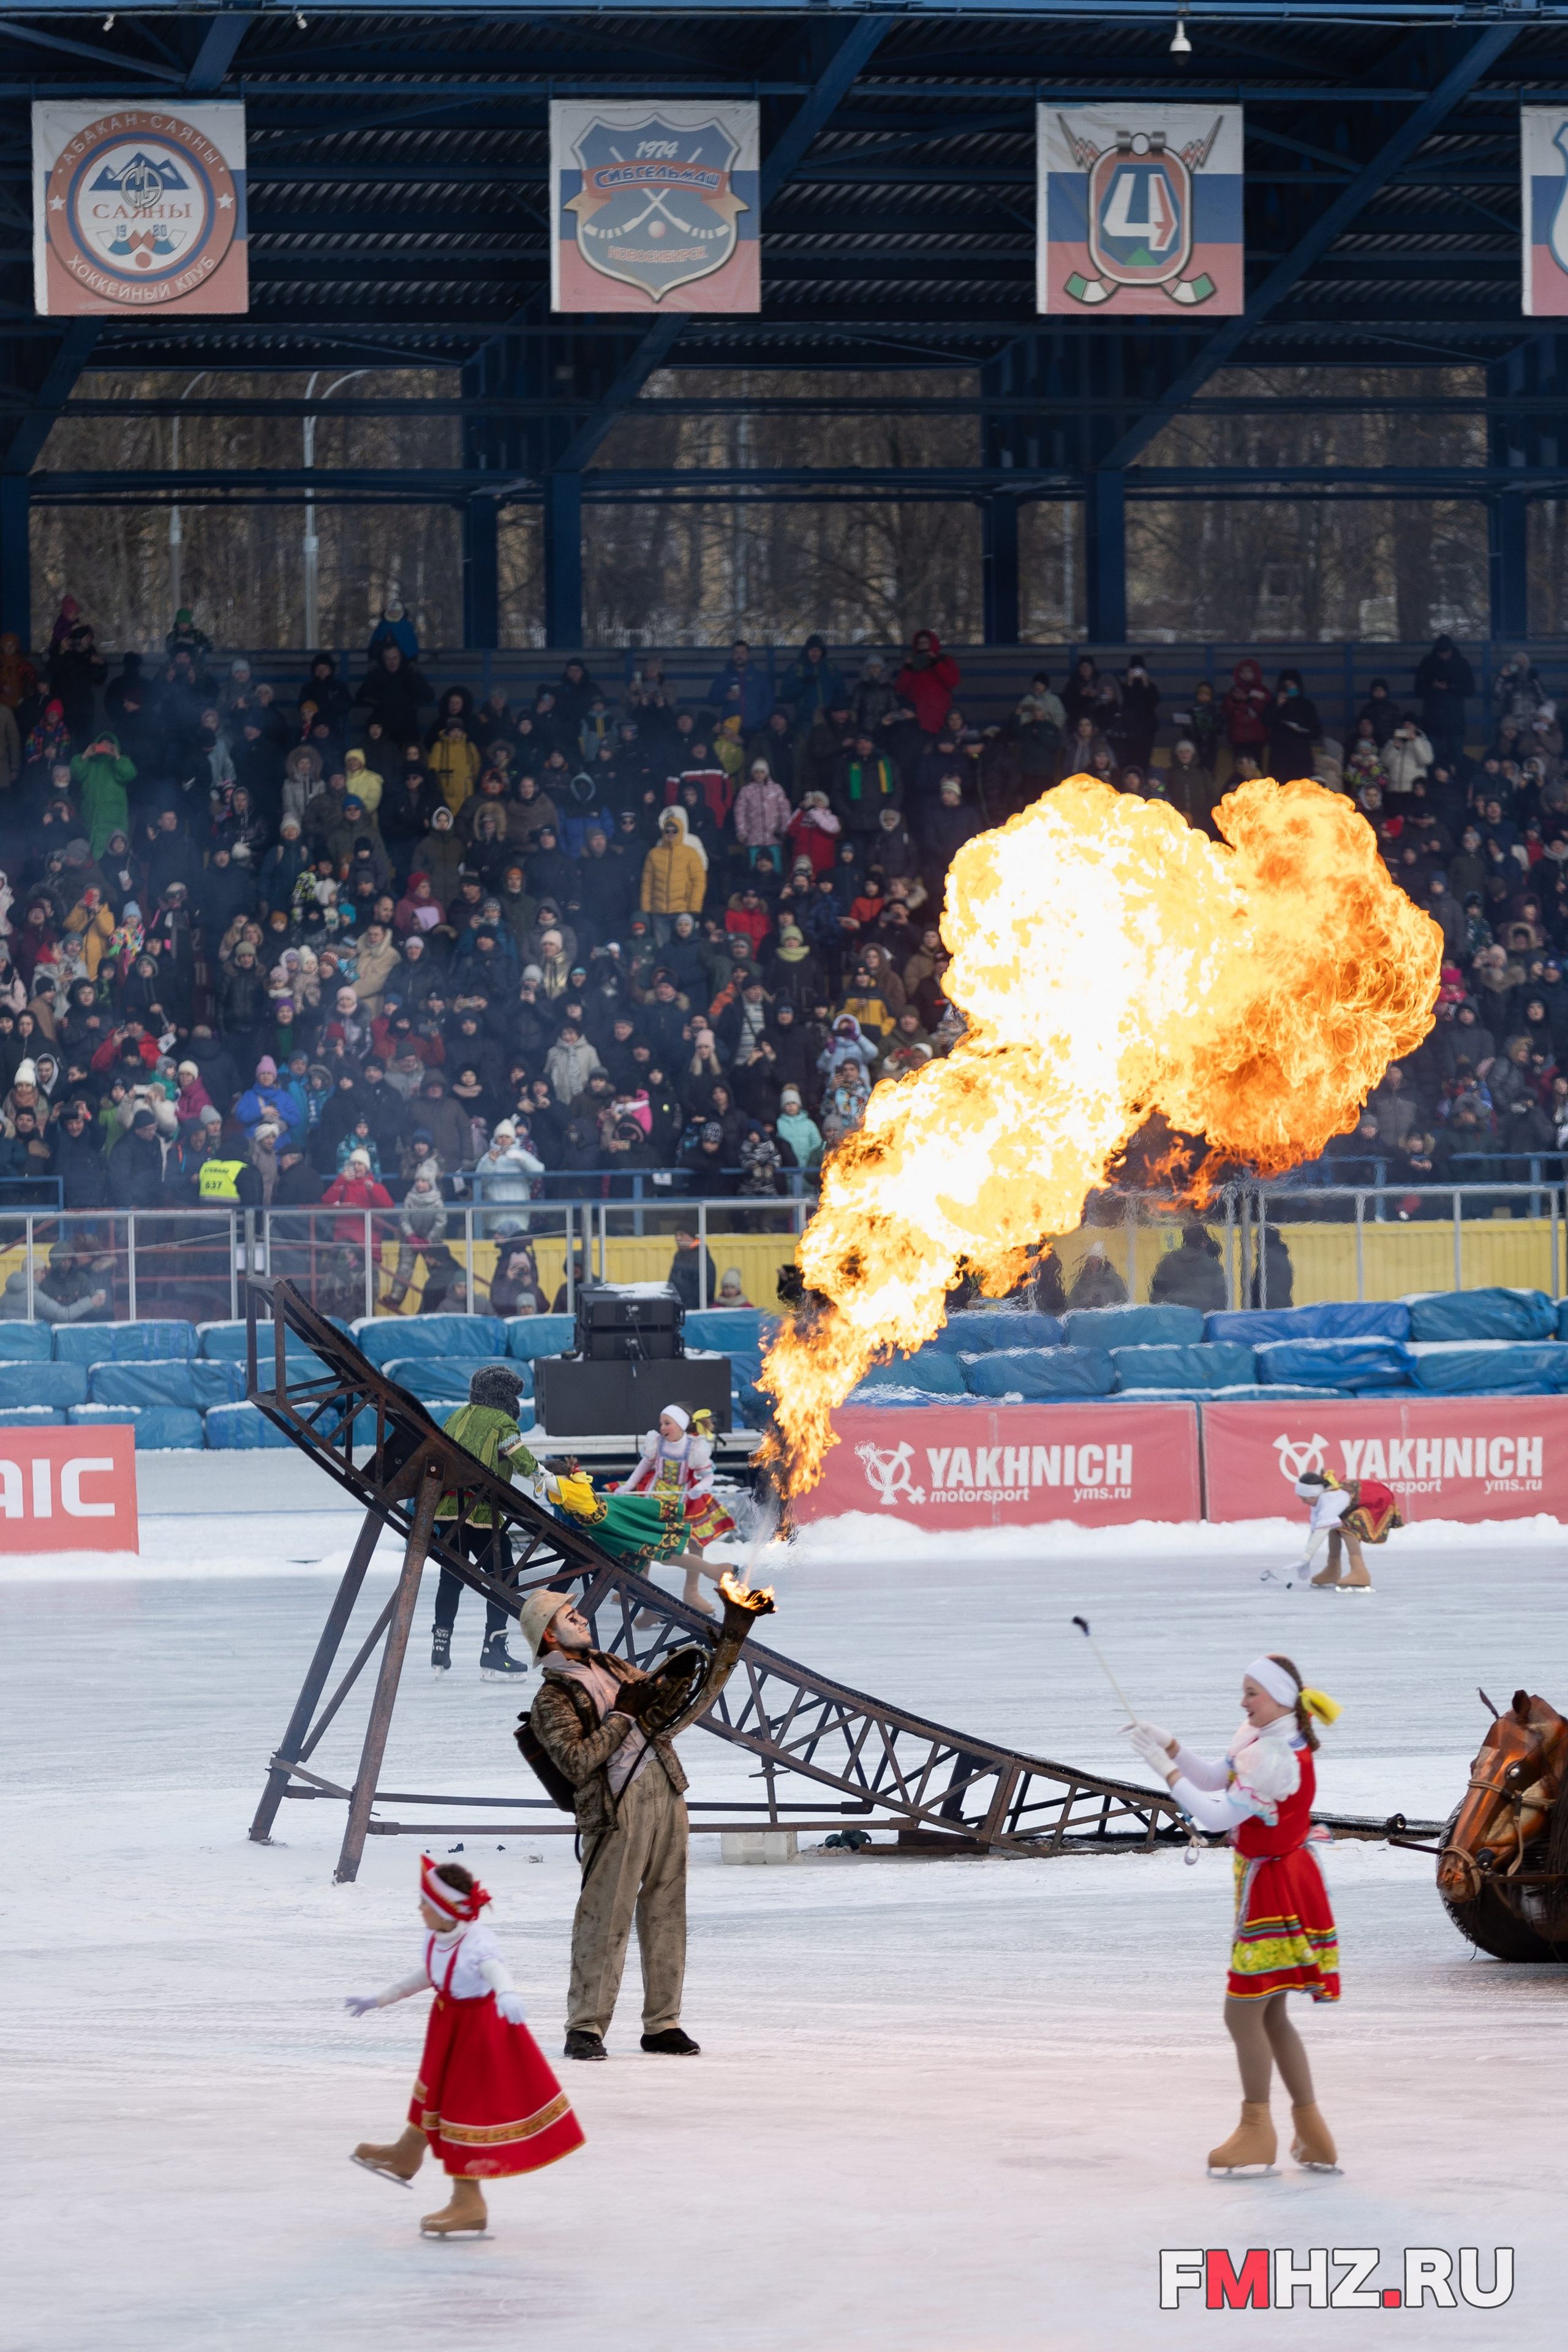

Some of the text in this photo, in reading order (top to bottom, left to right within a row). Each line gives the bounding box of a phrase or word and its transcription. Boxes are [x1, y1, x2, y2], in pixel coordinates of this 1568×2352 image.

[62, 113, 221, 166] АБАКАН-САЯНЫ
[635, 140, 679, 159] 1974
[593, 164, 722, 192] СИБСЕЛЬМАШ
[92, 203, 192, 219] САЯНЫ
[607, 246, 709, 263] НОВОСИБИРСК
[66, 254, 216, 302] ХОККЕЙНЫЙ КЛУБ
[925, 1443, 1133, 1489] YAKHNICH
[1339, 1436, 1544, 1480] YAKHNICH
[929, 1486, 1132, 1506] motorsport yms.ru
[1382, 1477, 1544, 1497] rsport yms.ru
